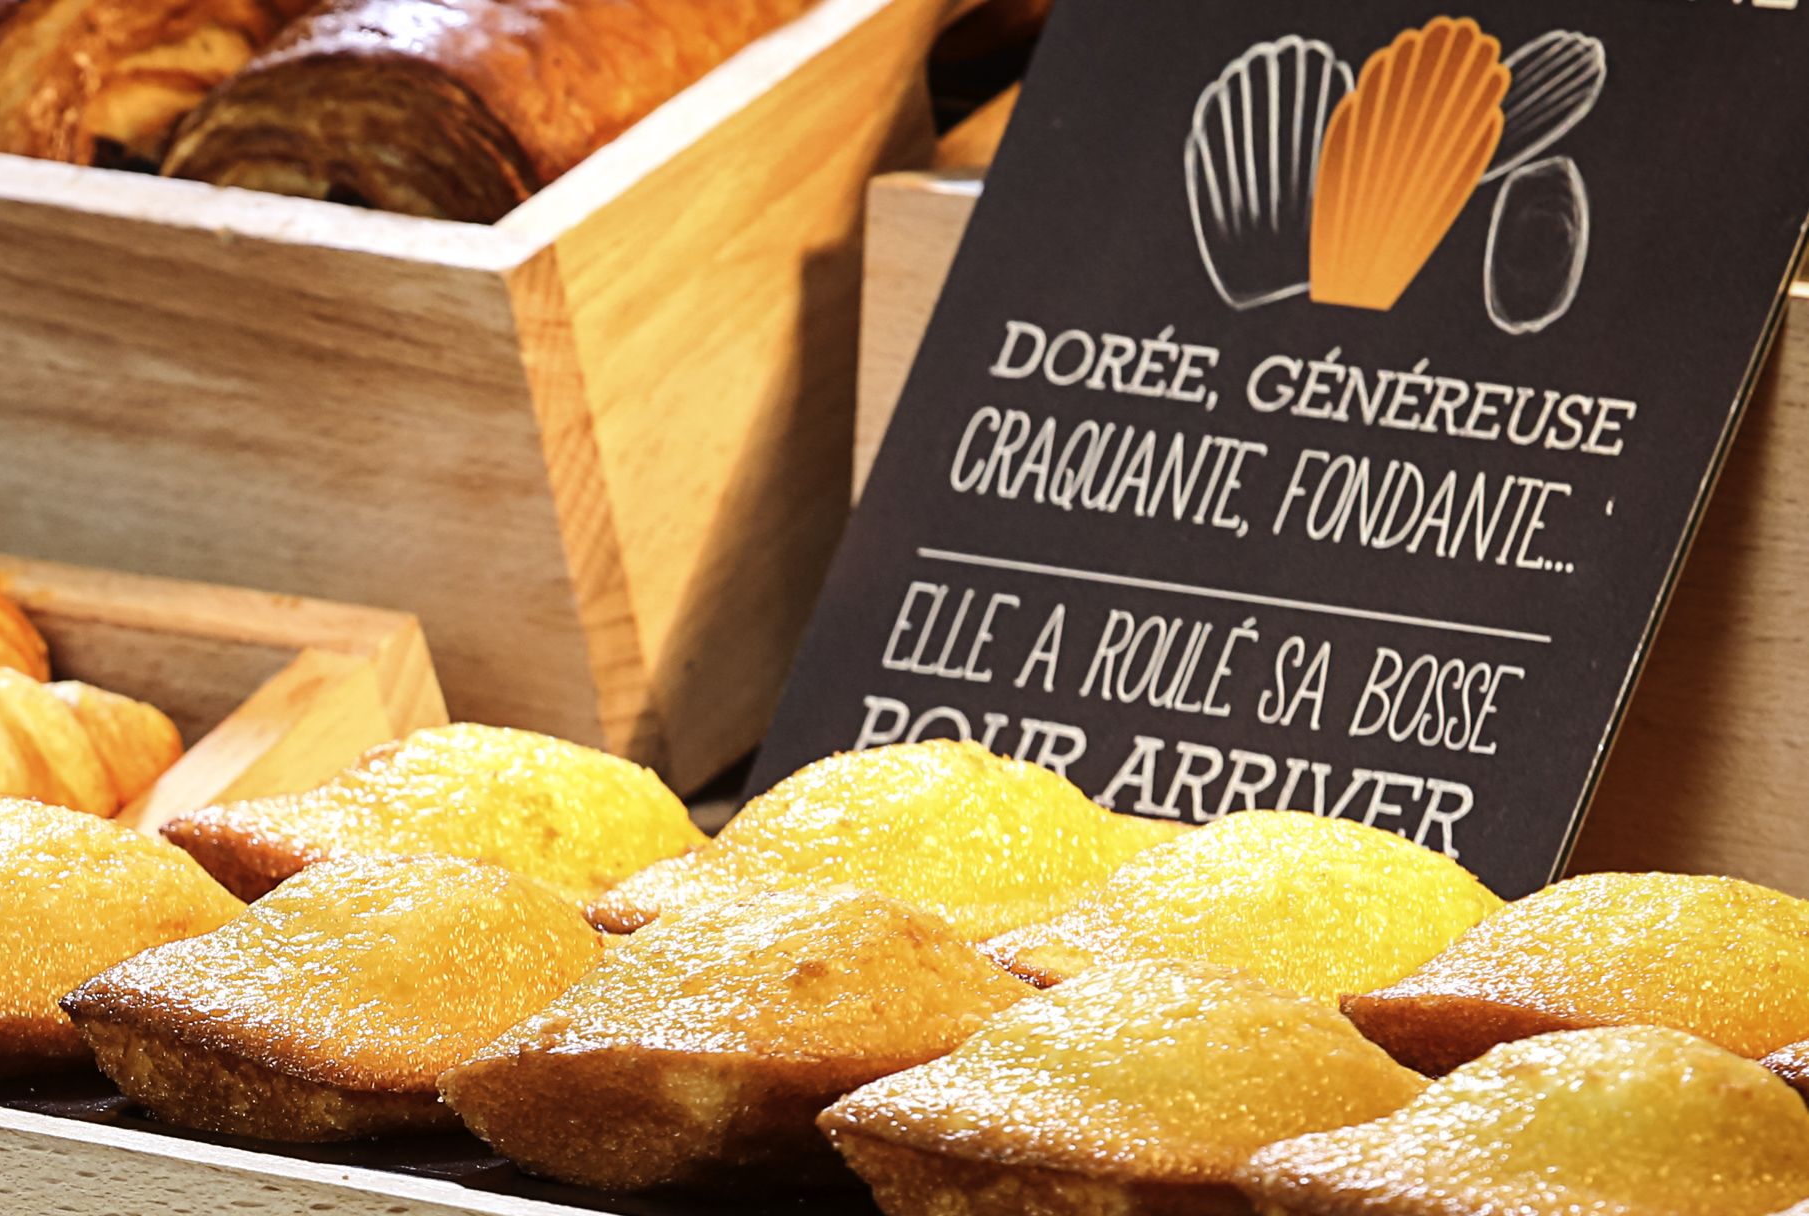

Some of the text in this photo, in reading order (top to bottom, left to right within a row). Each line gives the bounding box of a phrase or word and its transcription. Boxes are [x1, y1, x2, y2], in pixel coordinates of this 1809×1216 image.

[990, 320, 1637, 456] DORÉE, GÉNÉREUSE
[949, 406, 1575, 575] CRAQUANTE, FONDANTE...
[882, 580, 1526, 755] ELLE A ROULÉ SA BOSSE
[1091, 733, 1476, 860] ARRIVER
